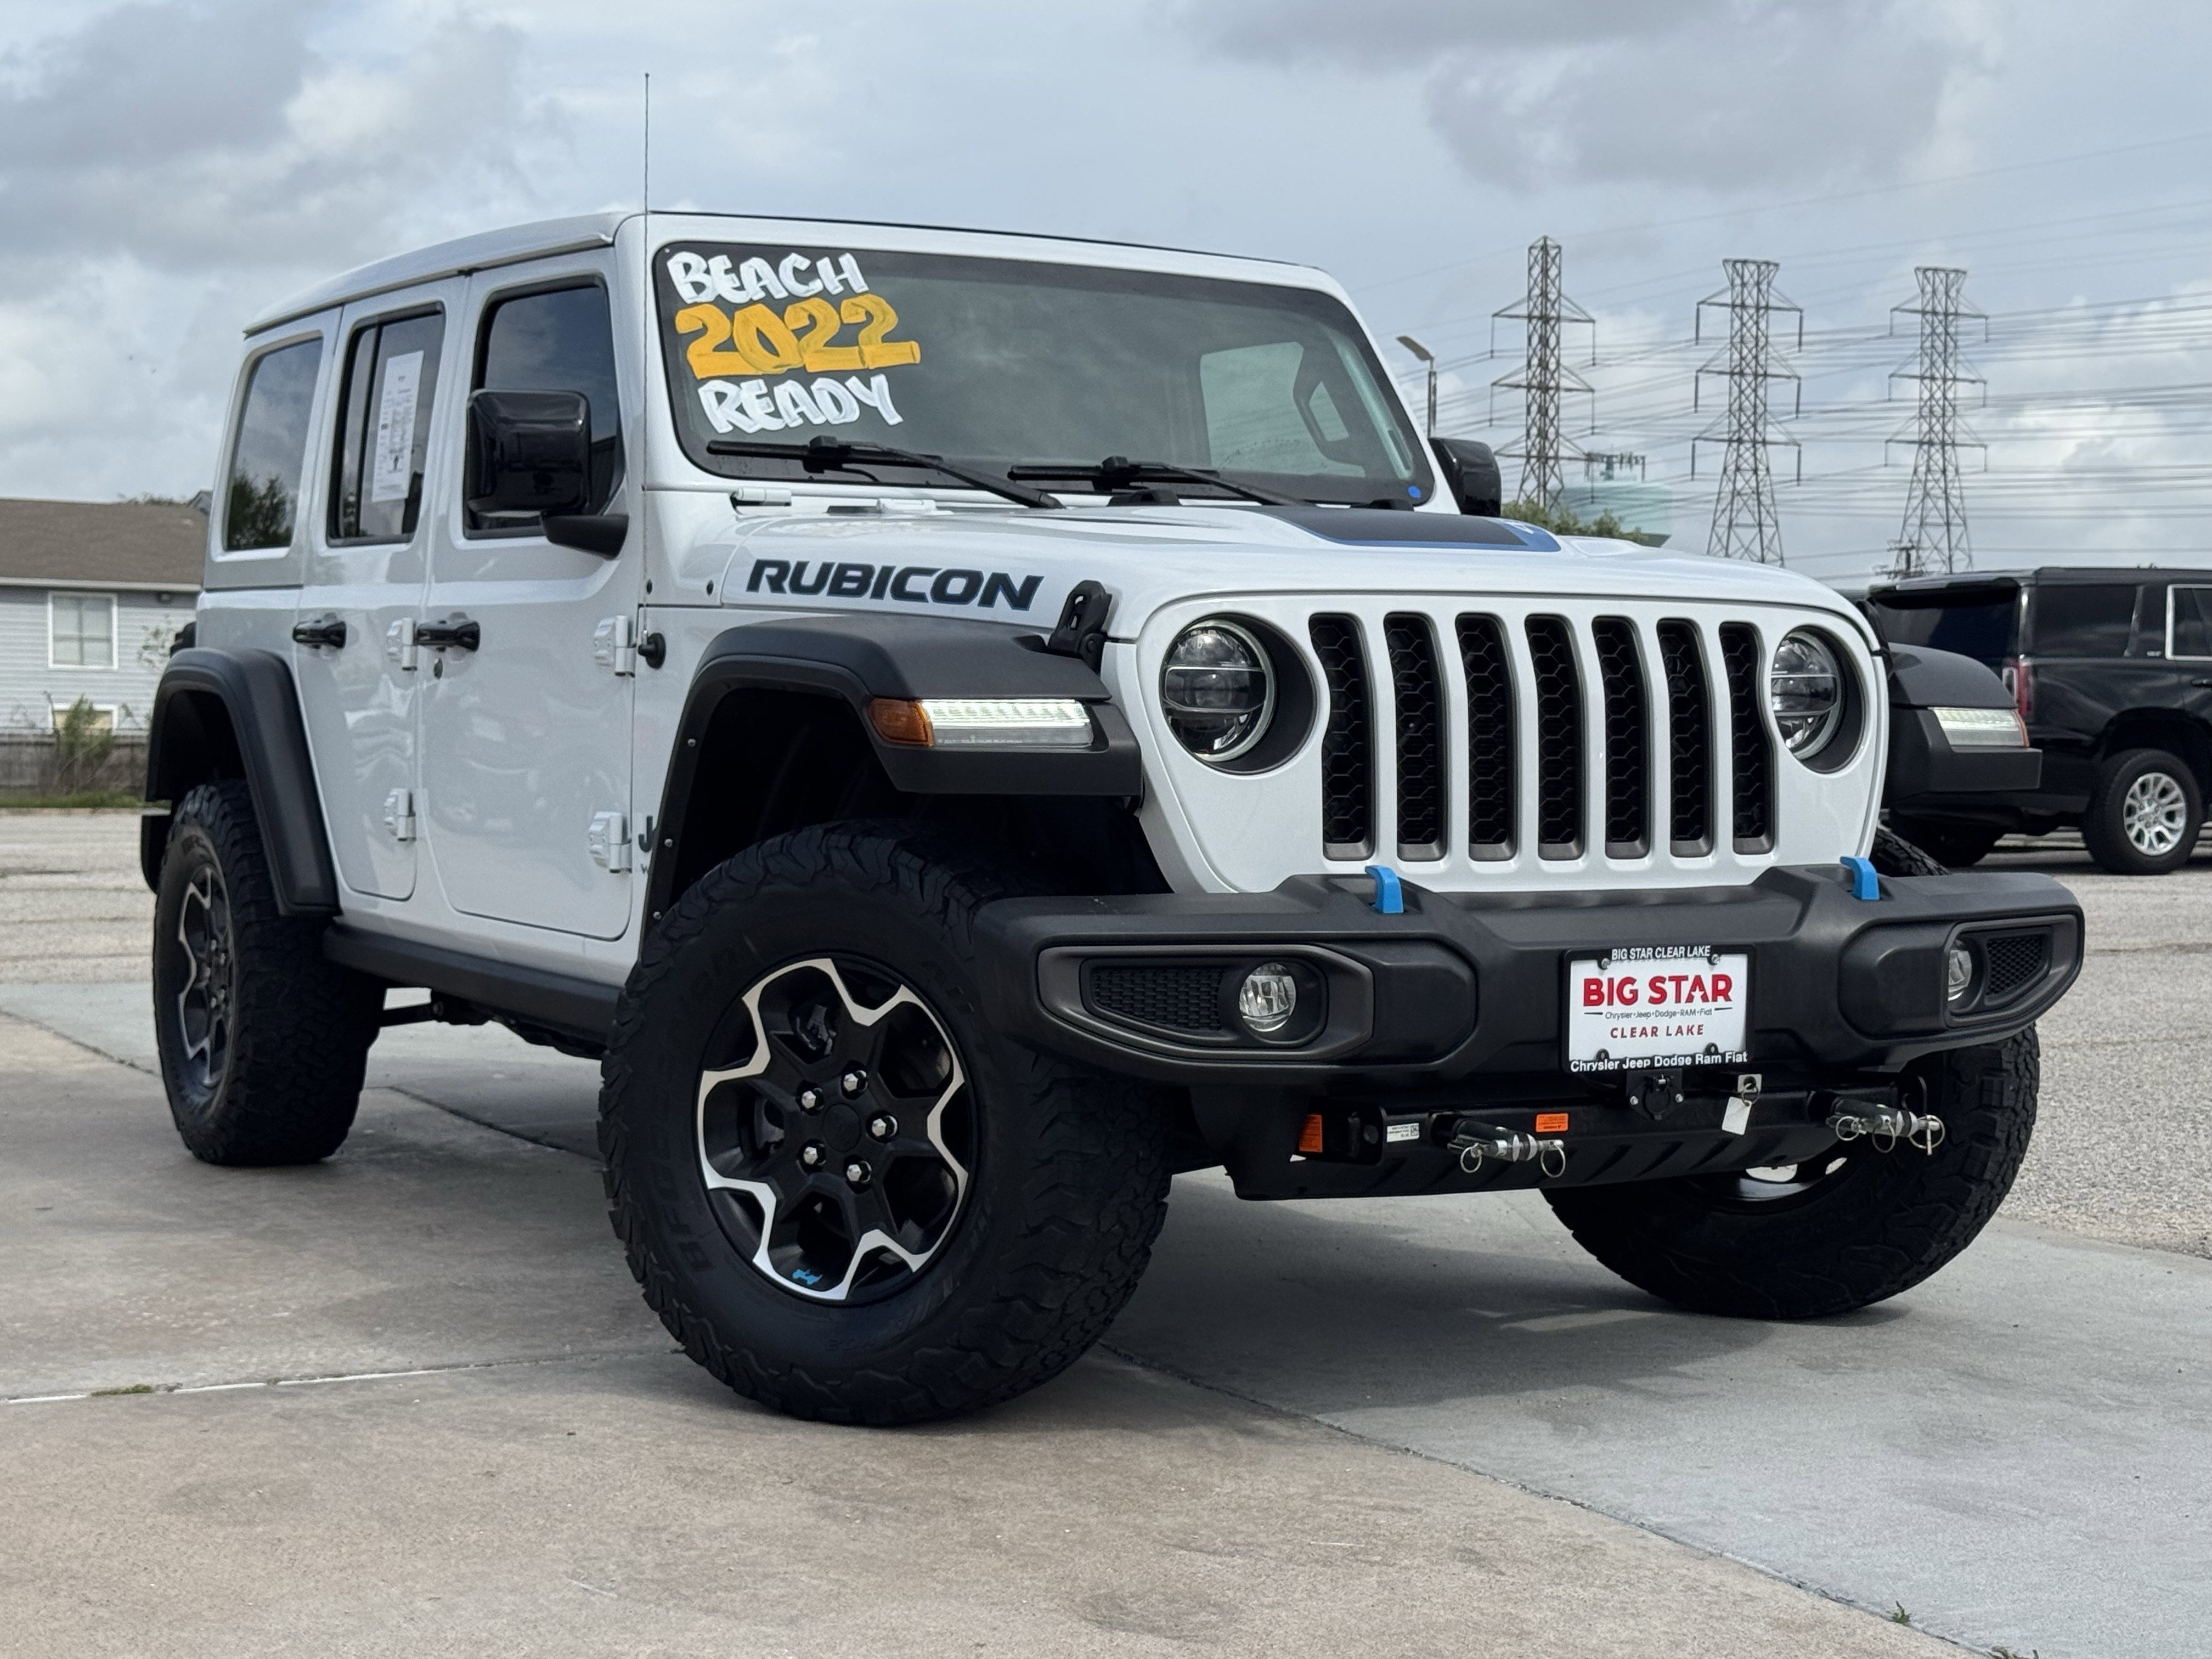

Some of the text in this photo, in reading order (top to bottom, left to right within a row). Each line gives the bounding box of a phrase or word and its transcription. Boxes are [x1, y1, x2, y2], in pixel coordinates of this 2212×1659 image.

[667, 252, 869, 304] BEACH
[675, 294, 921, 380] 2022
[698, 374, 903, 434] READY
[746, 559, 1045, 611] RUBICON
[1612, 945, 1711, 960] BIG STAR CLEAR LAKE
[1583, 974, 1733, 1006] BIG STAR
[1610, 1024, 1704, 1039] CLEAR LAKE
[1570, 1051, 1748, 1073] Chrysler Jeep Dodge Ram Fiat
